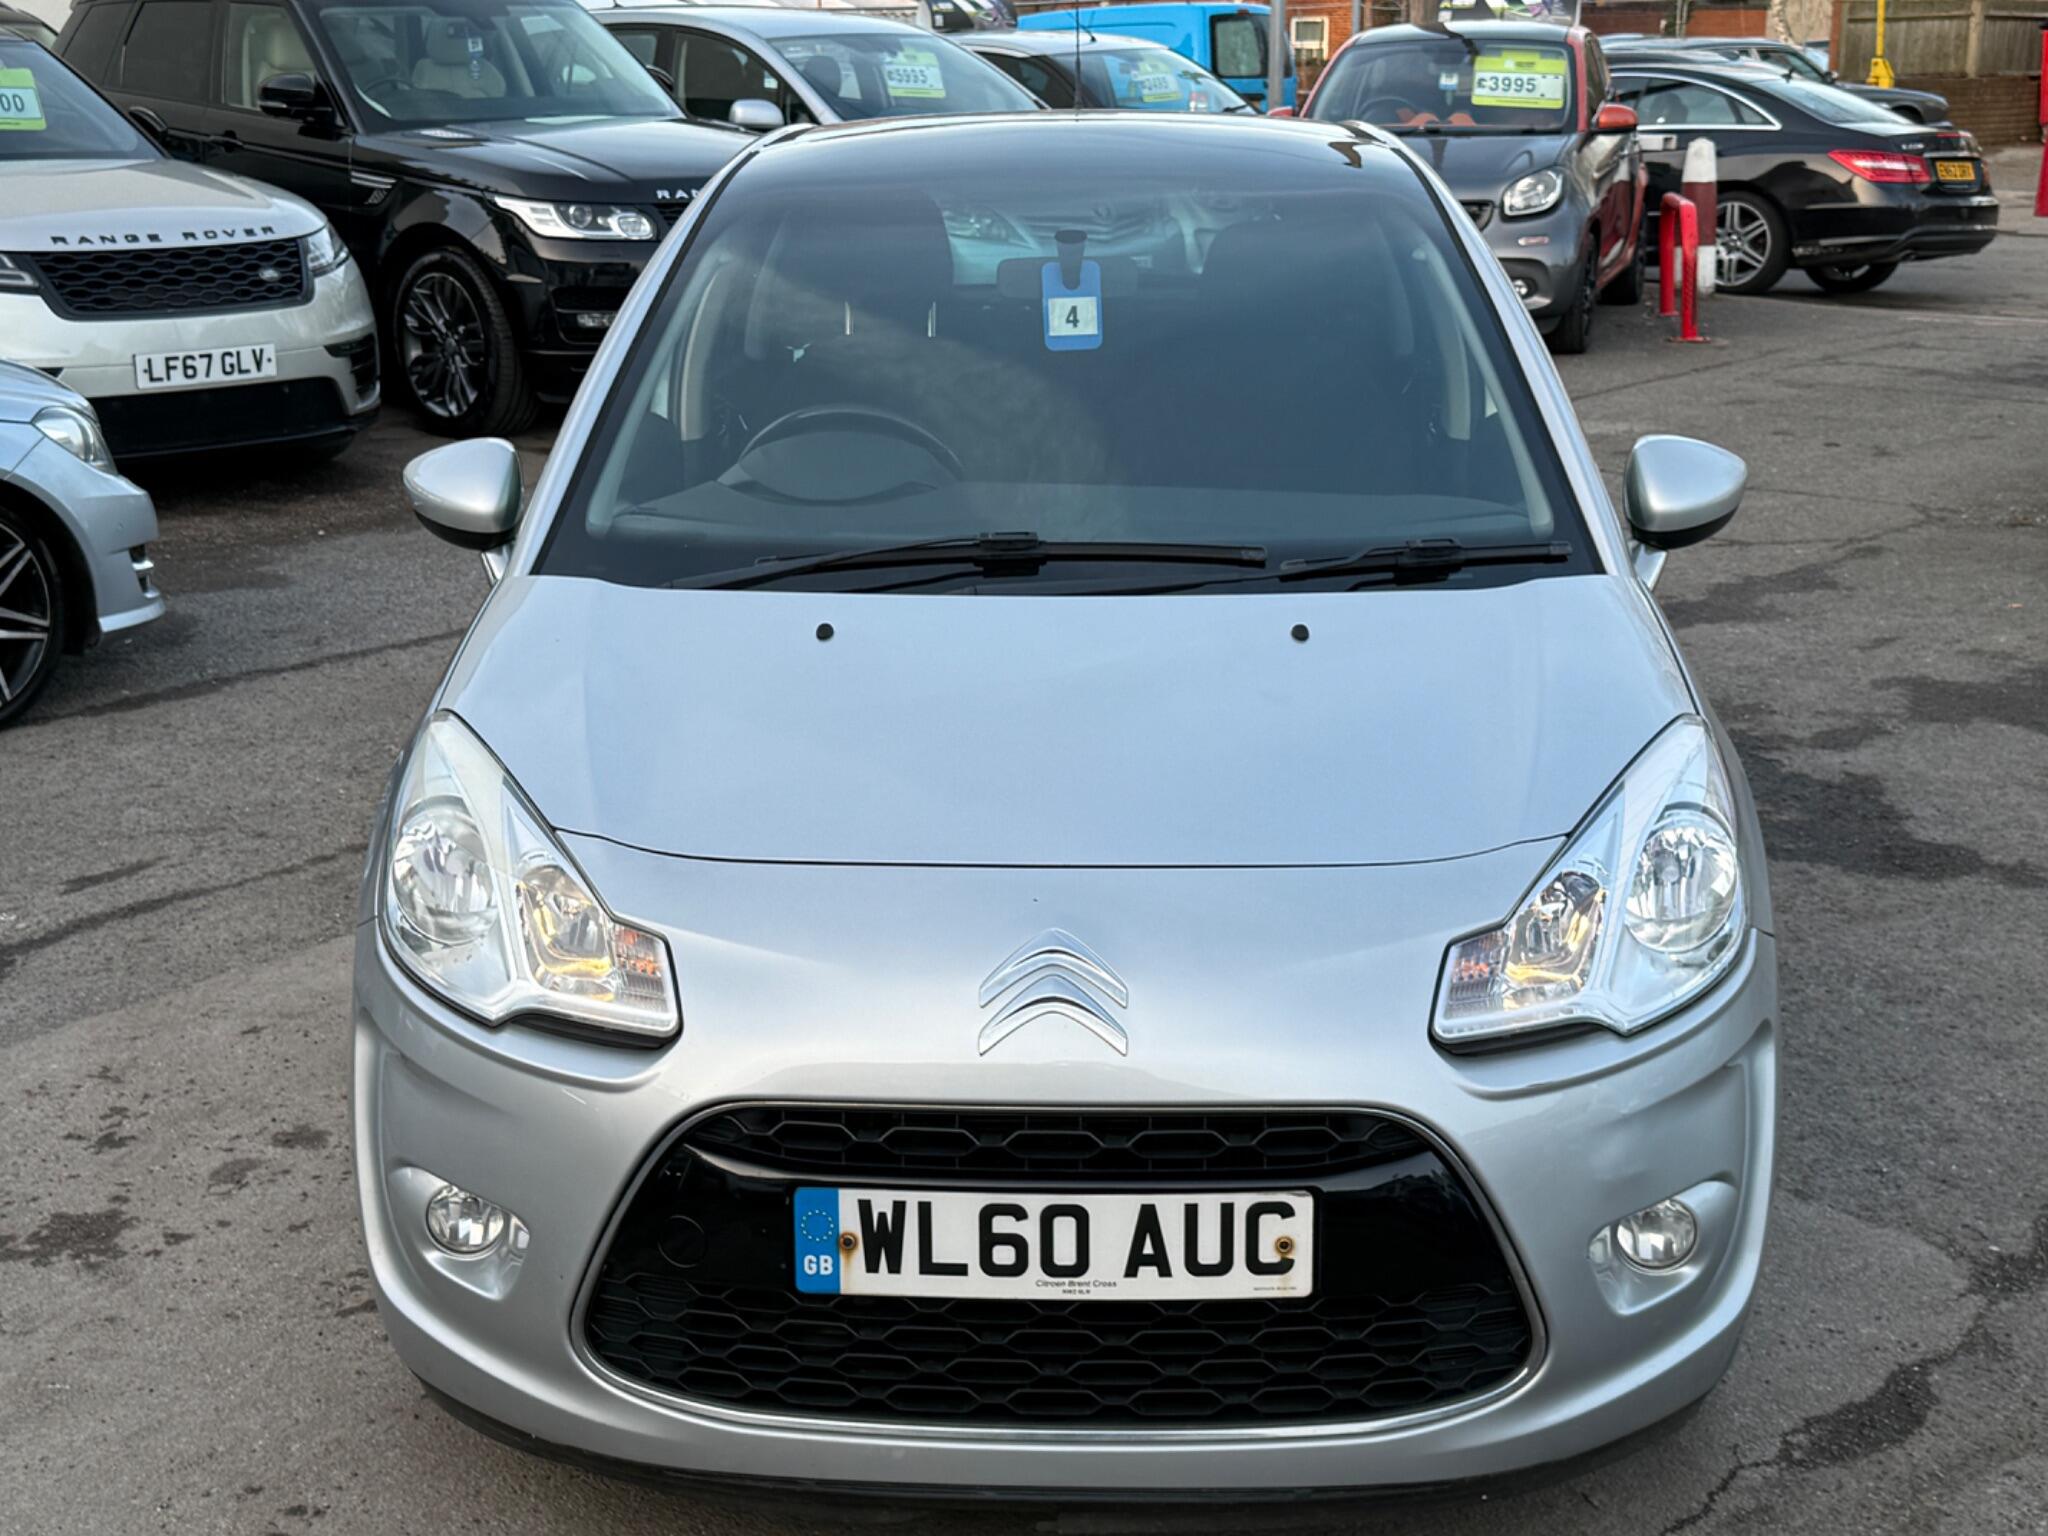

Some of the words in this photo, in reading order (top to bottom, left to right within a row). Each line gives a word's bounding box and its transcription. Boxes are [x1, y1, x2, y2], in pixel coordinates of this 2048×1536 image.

[1476, 76, 1536, 93] £3995
[51, 233, 162, 246] RANGE
[182, 226, 276, 241] ROVER
[1065, 304, 1080, 328] 4
[147, 354, 213, 383] LF67
[221, 348, 265, 375] GLV
[857, 1198, 1090, 1278] WL60
[1123, 1201, 1296, 1278] AUC
[803, 1255, 833, 1276] GB
[1067, 1280, 1091, 1288] Brent
[1092, 1279, 1117, 1288] Cross
